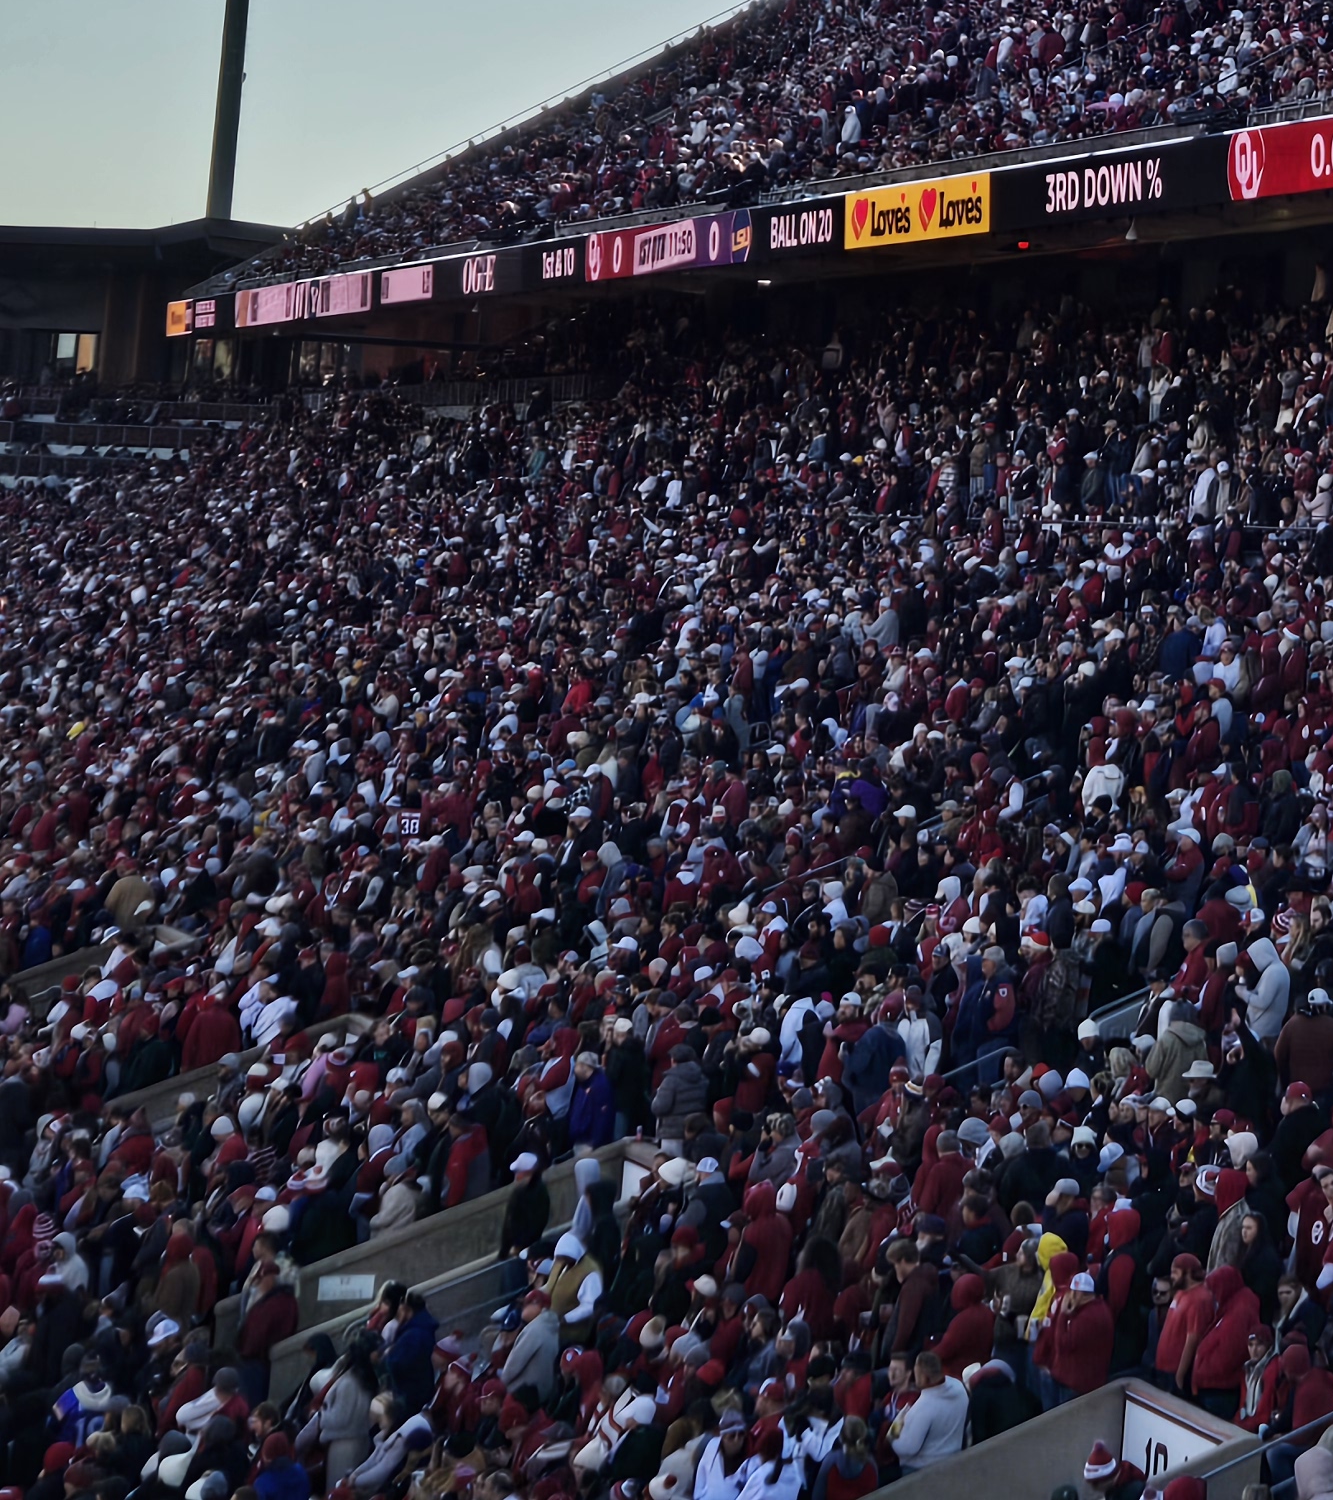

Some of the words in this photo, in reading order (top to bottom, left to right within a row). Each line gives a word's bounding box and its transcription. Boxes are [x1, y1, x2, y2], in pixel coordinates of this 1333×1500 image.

[870, 193, 911, 238] Love's
[938, 181, 983, 230] Love's
[1045, 173, 1078, 214] 3RD
[1084, 160, 1143, 207] DOWN
[1146, 157, 1163, 200] %
[613, 236, 622, 273] 0
[709, 221, 719, 262] 0
[770, 214, 799, 249] BALL
[800, 211, 817, 245] ON
[817, 208, 833, 243] 20
